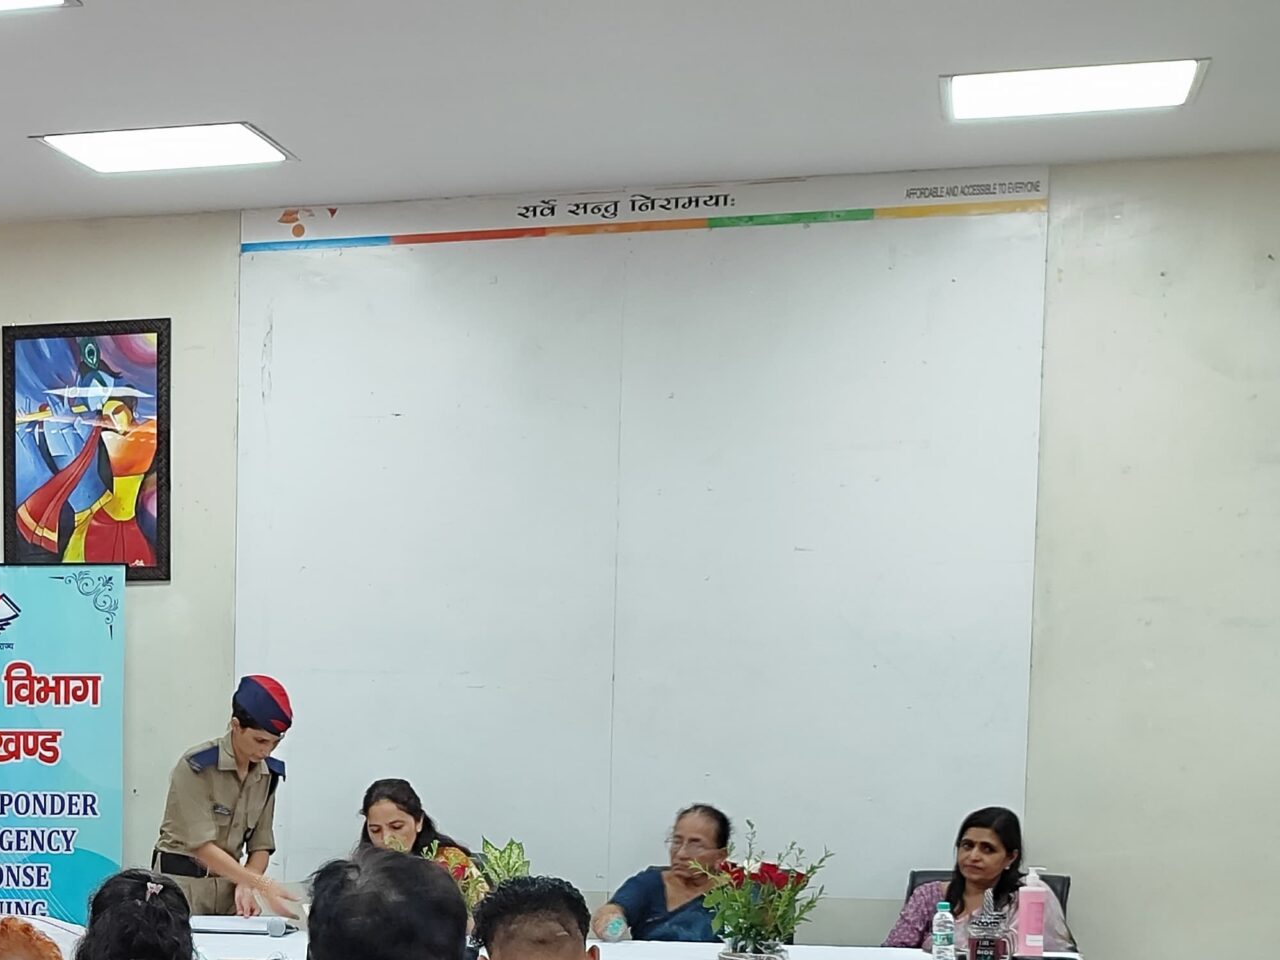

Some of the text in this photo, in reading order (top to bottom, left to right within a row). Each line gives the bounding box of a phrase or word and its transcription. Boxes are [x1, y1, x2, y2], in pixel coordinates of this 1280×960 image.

[945, 185, 959, 197] AND
[517, 199, 557, 219] सर्वे
[568, 200, 620, 219] सन्तु
[4, 661, 102, 706] विभाग
